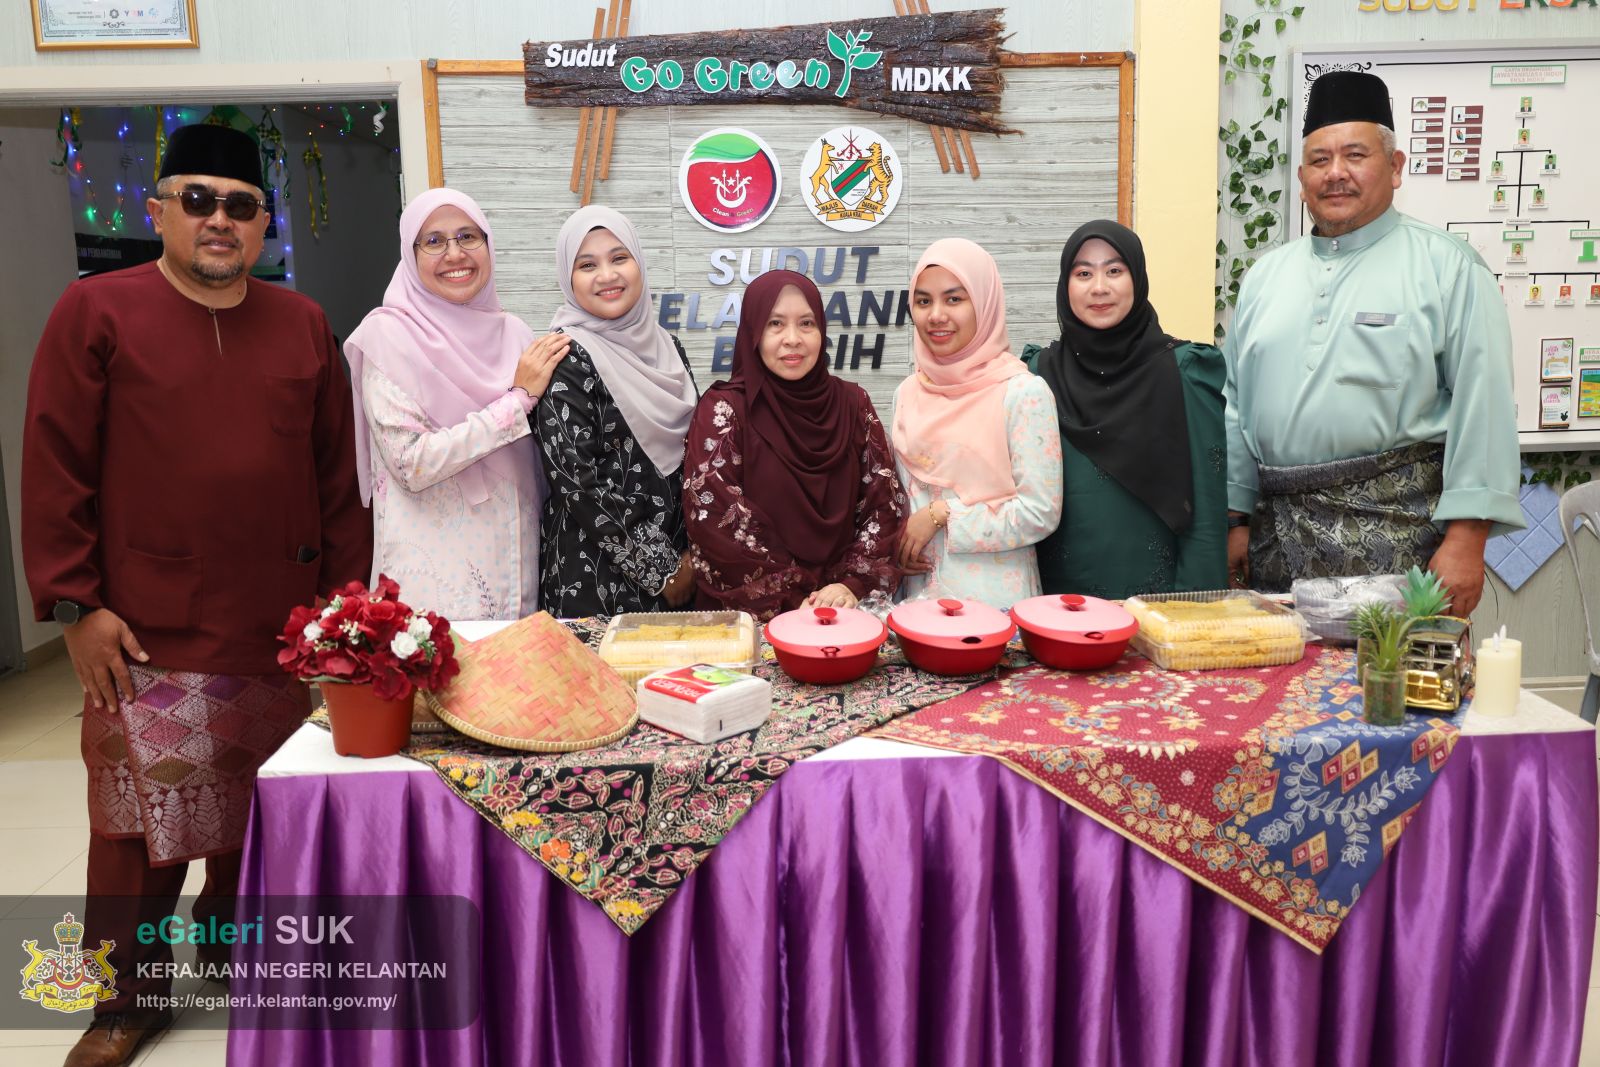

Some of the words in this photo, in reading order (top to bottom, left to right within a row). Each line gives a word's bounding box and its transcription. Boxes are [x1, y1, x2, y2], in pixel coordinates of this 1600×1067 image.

[545, 43, 617, 68] Sudut
[620, 56, 684, 93] Go
[694, 57, 831, 93] Green
[891, 66, 972, 92] MDKK
[712, 207, 730, 217] Clean
[707, 246, 880, 286] SUDUT
